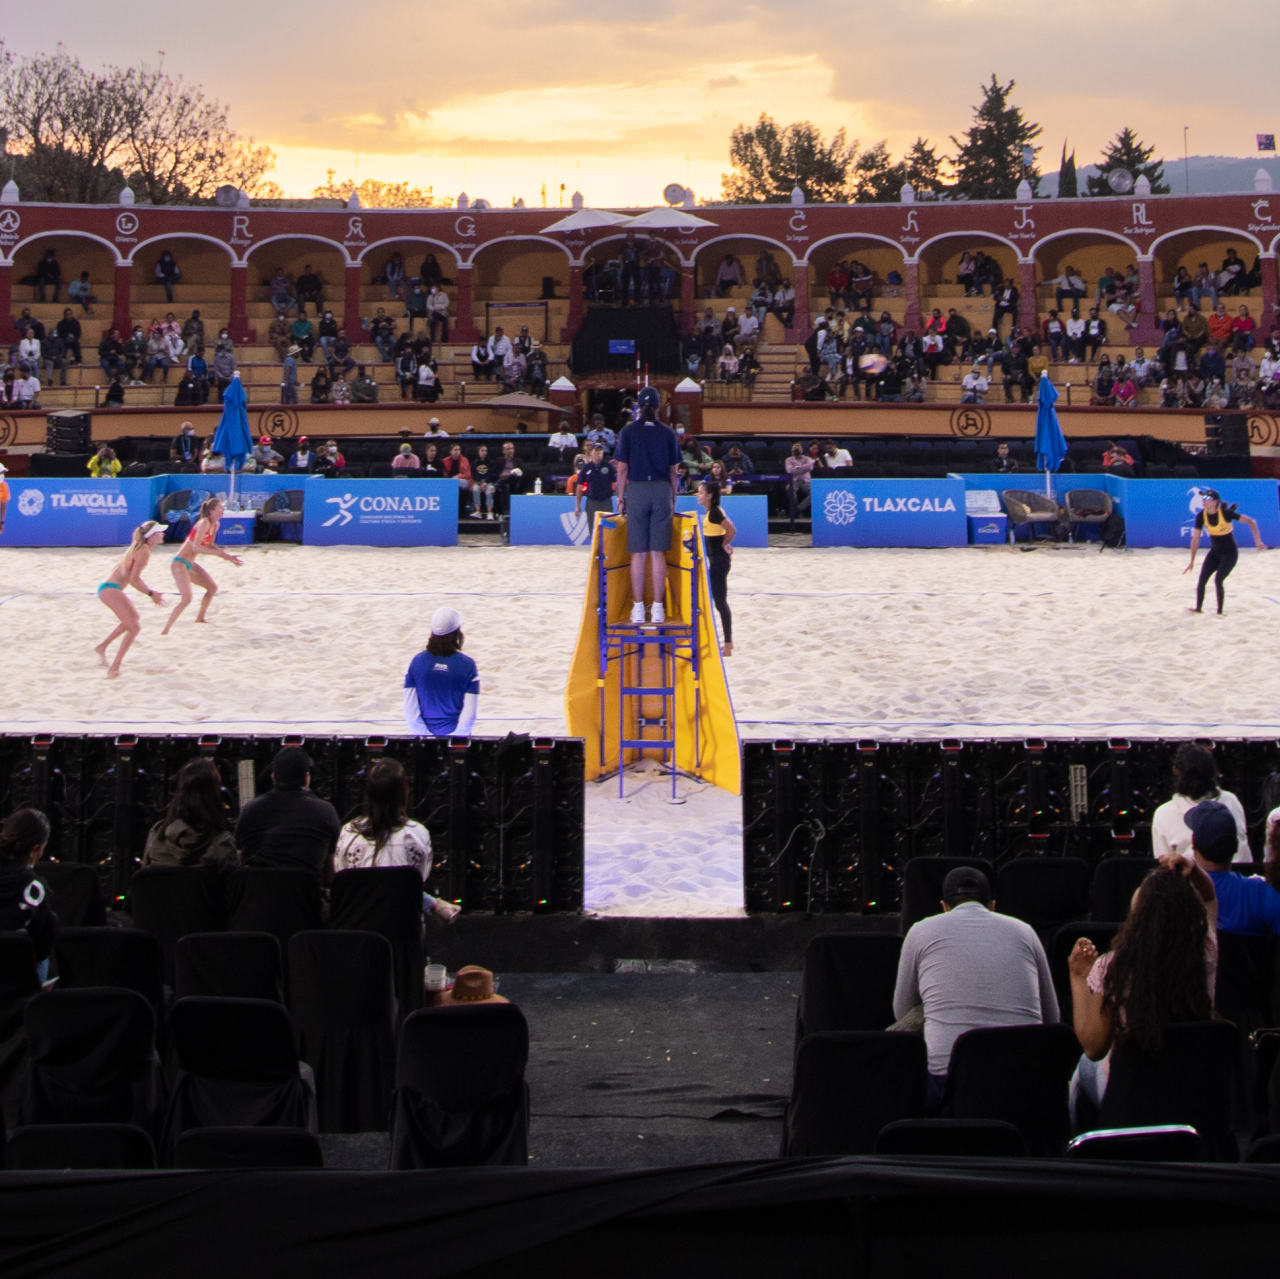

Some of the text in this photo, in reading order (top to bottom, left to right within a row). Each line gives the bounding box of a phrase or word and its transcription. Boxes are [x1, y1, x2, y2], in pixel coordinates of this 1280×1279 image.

[50, 493, 128, 507] TLAXCALA
[360, 496, 440, 512] CONADE
[862, 497, 957, 512] TLAXCALA
